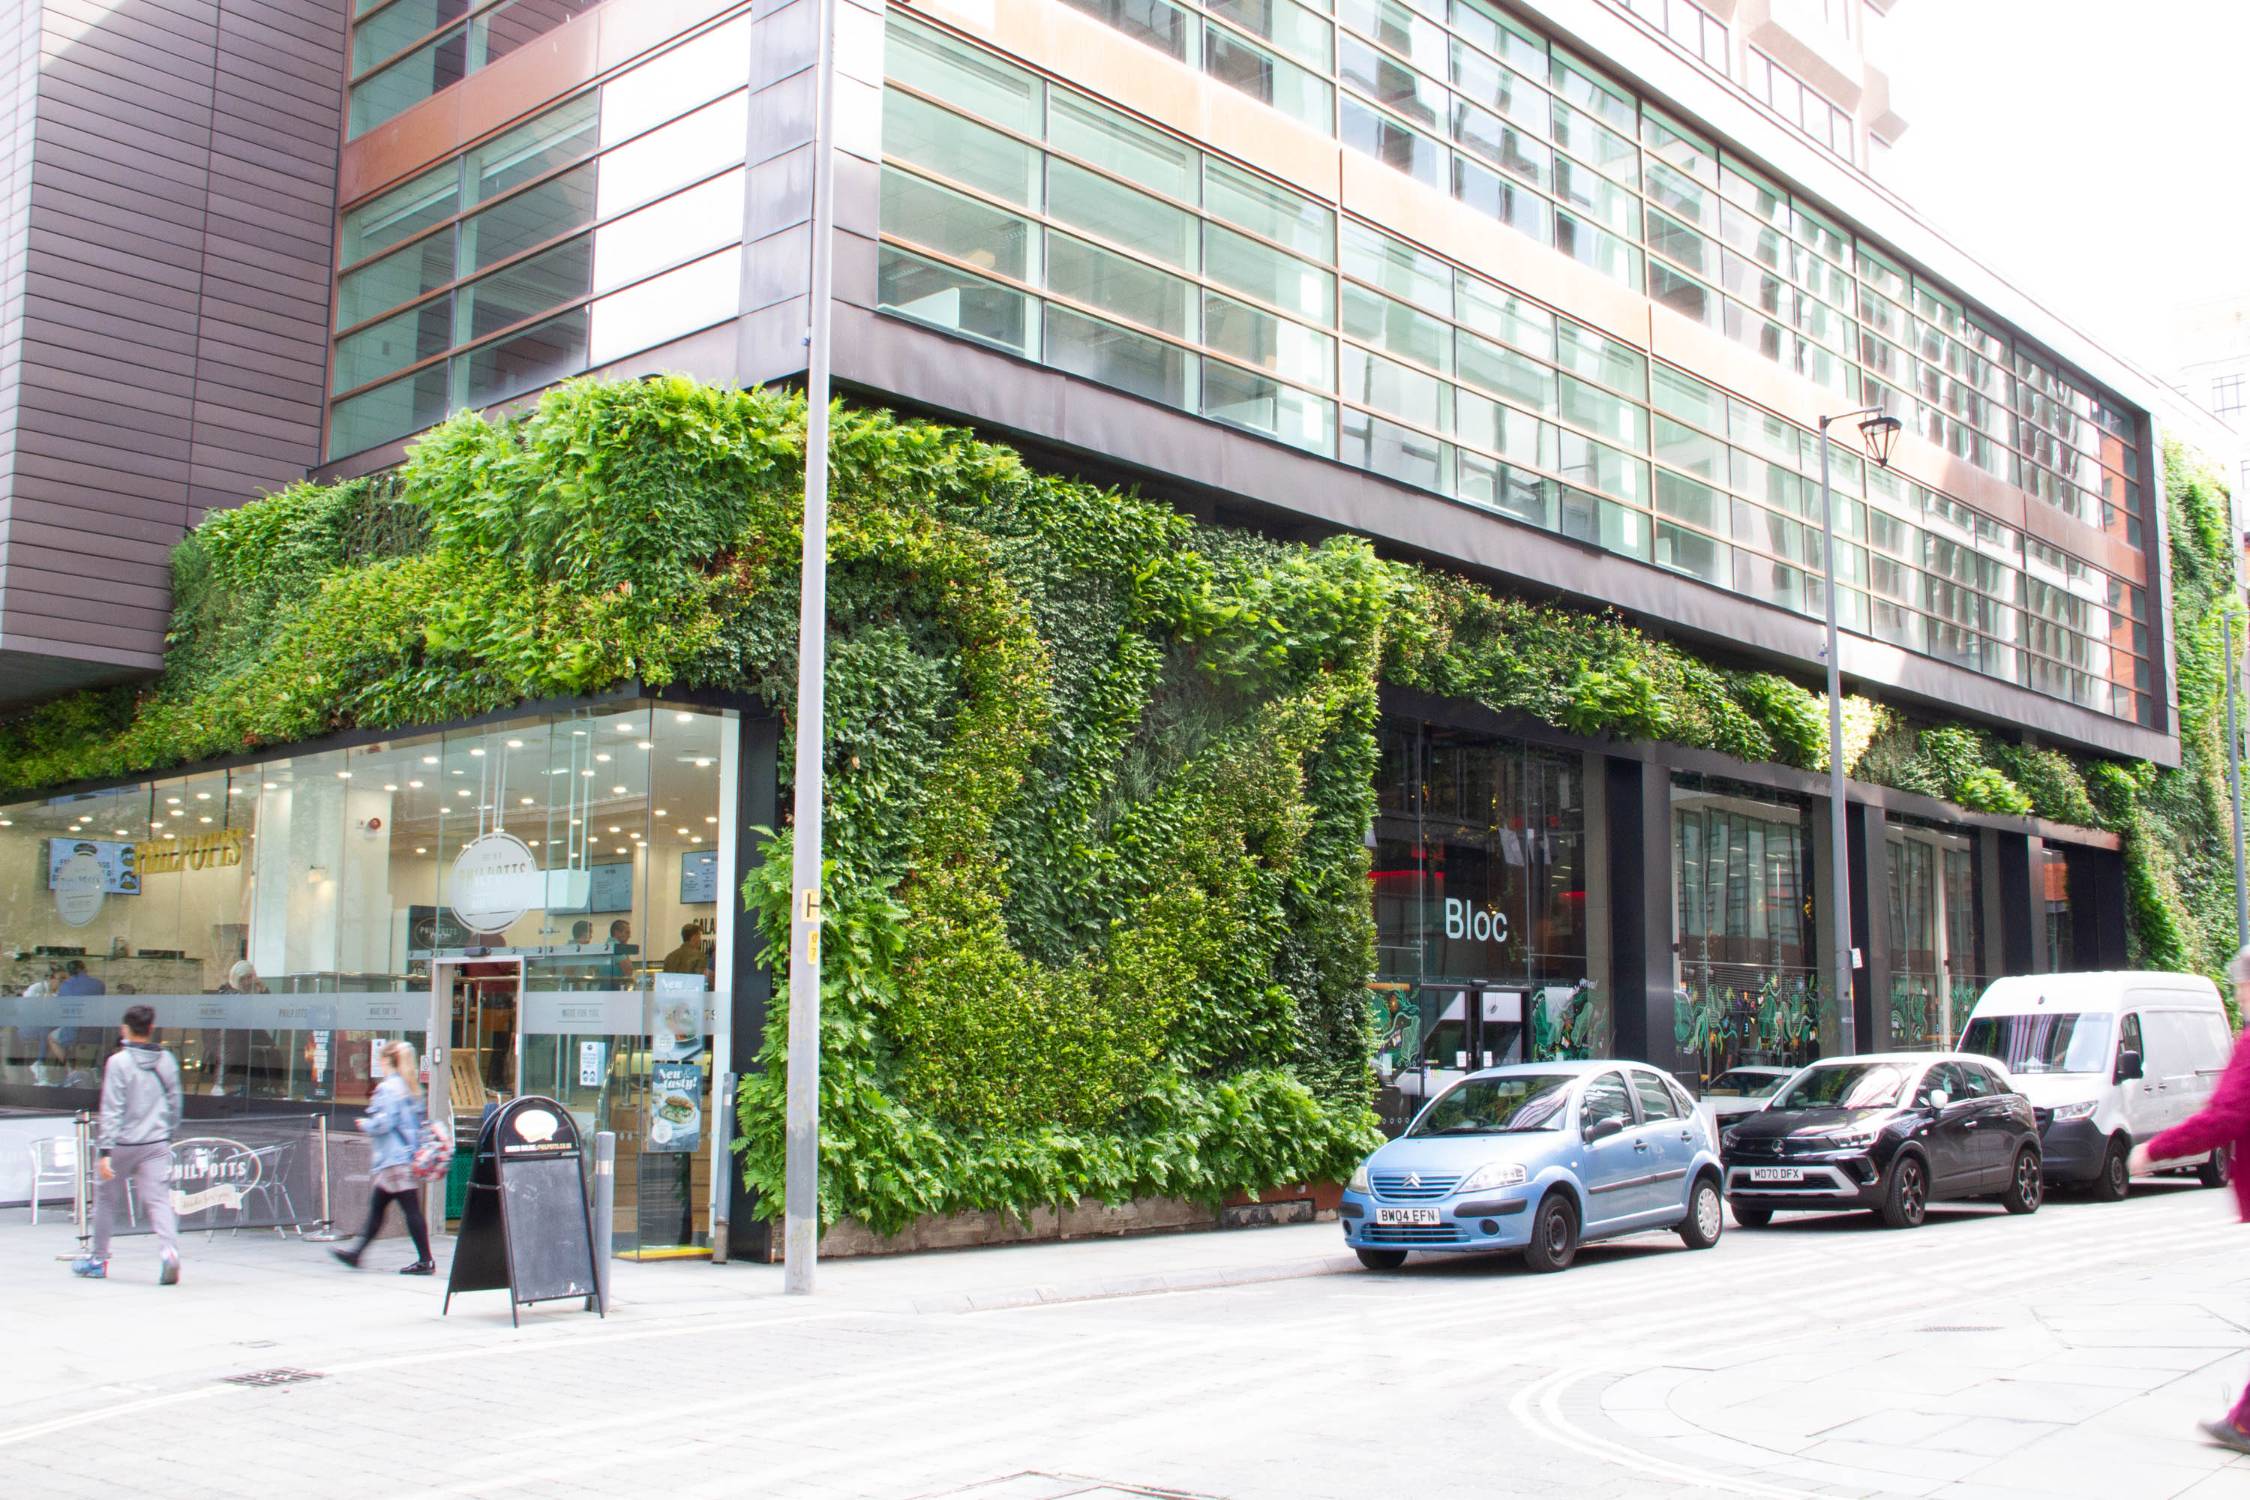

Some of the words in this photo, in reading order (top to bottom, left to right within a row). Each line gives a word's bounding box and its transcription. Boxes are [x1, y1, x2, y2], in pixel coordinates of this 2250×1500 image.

[1445, 897, 1508, 942] Bloc
[665, 1076, 698, 1090] tasty!
[1755, 1169, 1779, 1179] MD70
[1780, 1168, 1799, 1178] DFX
[1381, 1209, 1409, 1221] BW04
[1412, 1210, 1435, 1221] EFN
